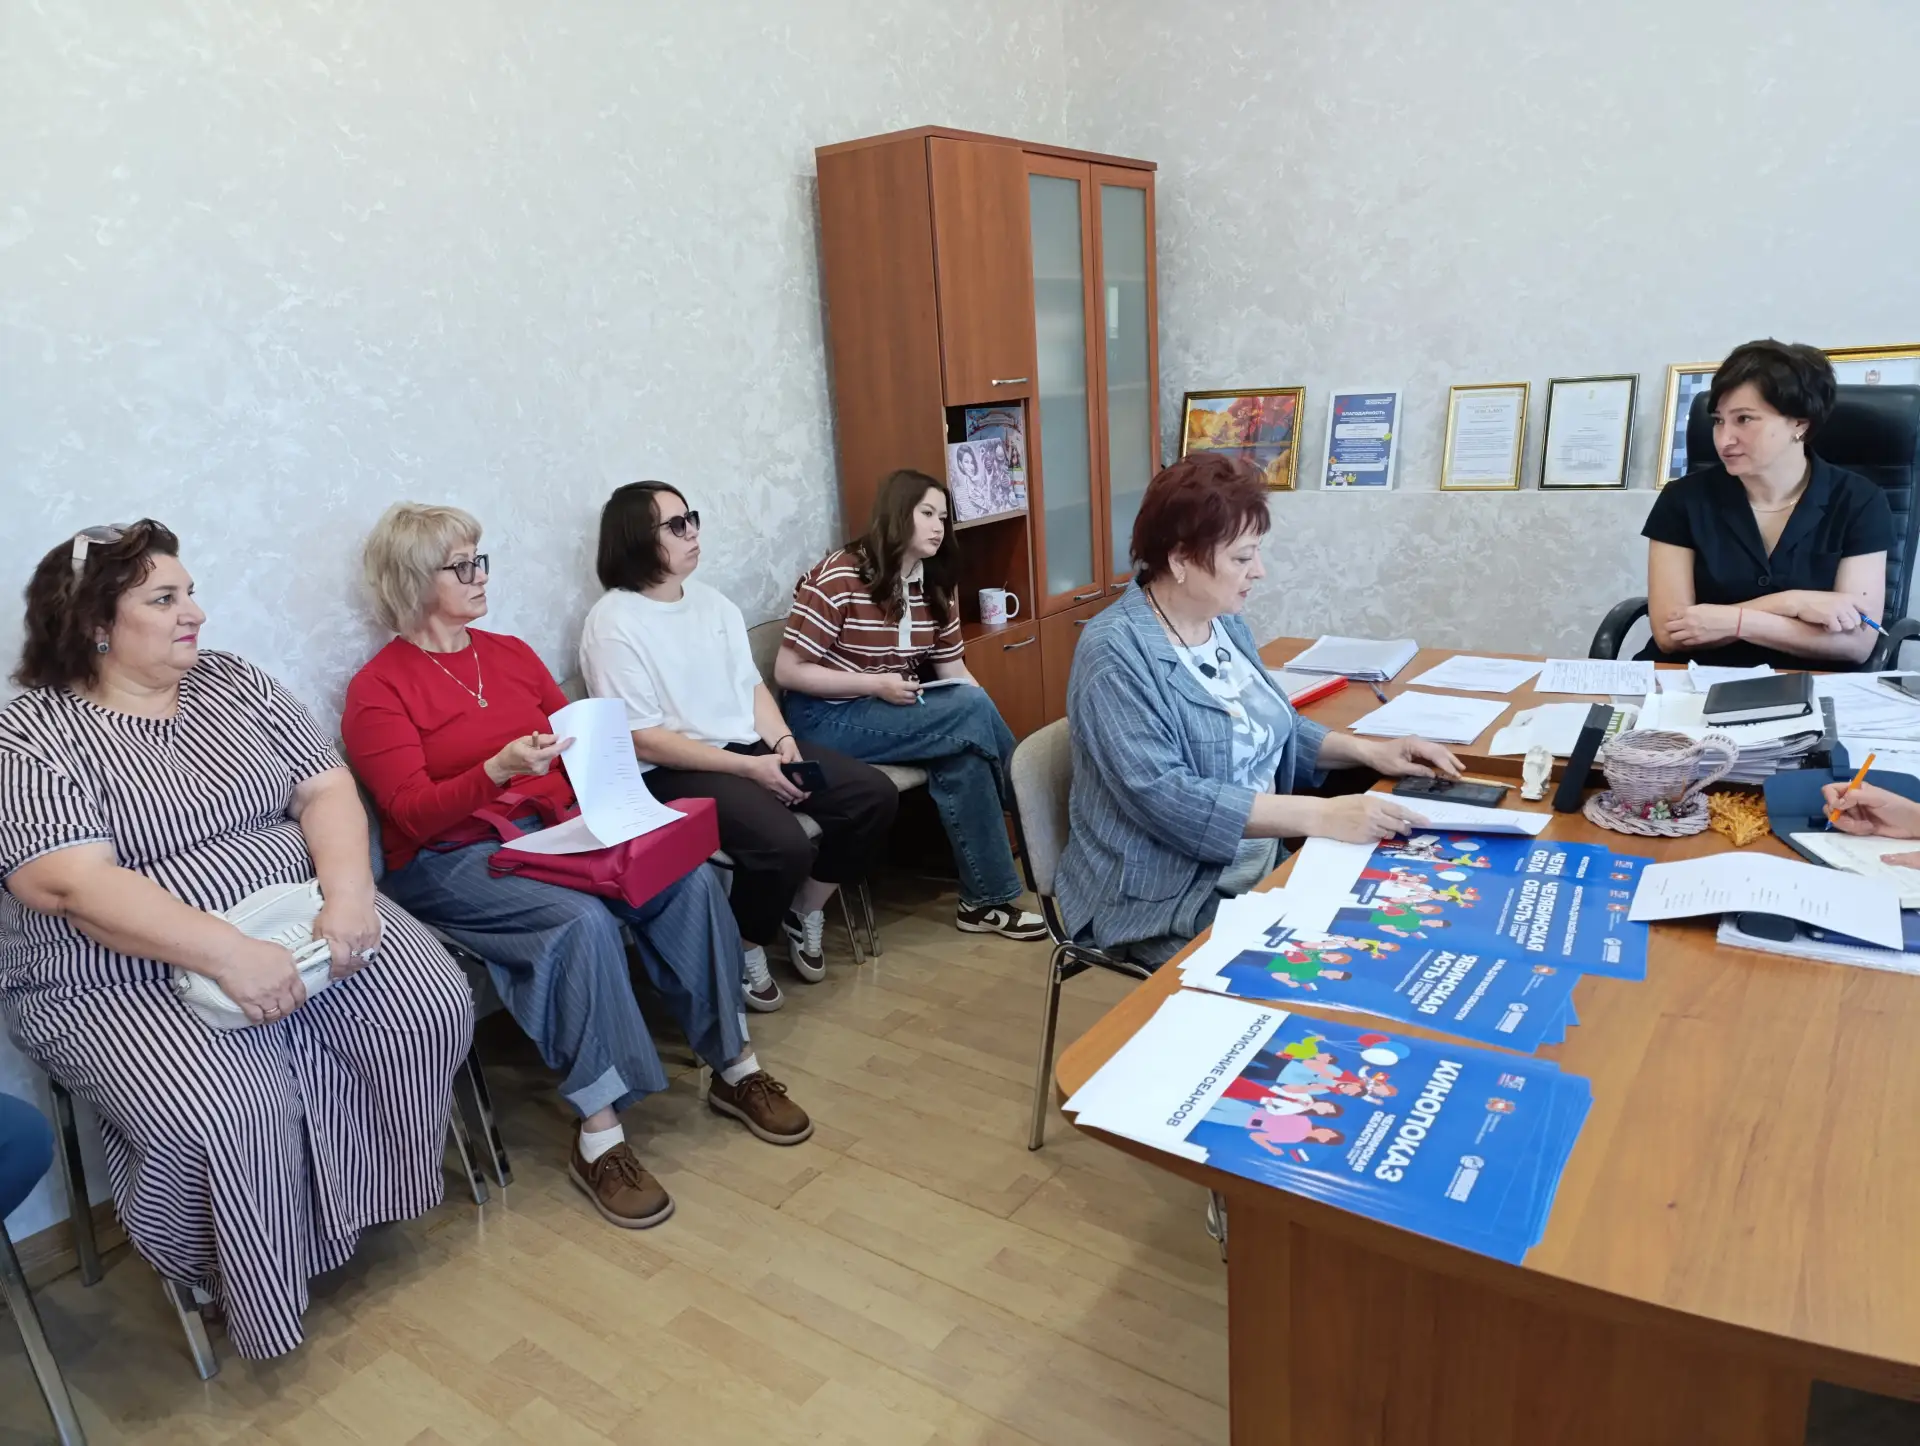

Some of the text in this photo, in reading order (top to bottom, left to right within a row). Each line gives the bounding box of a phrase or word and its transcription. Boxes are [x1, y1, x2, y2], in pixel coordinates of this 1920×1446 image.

[1526, 850, 1549, 873] ОБЛА
[1544, 852, 1567, 876] ЧЕЛЯ
[1514, 880, 1540, 922] ОБЛАСТЬ
[1526, 882, 1559, 952] ЧЕЛЯБИНСКАЯ
[1417, 954, 1479, 1015] ЯБИНСКАЯ
[1423, 950, 1457, 980] АСТЬ
[1166, 1013, 1271, 1127] РАСПИСАНИЕ СЕАНСОВ
[1374, 1059, 1463, 1182] КИНОПОКАЗ
